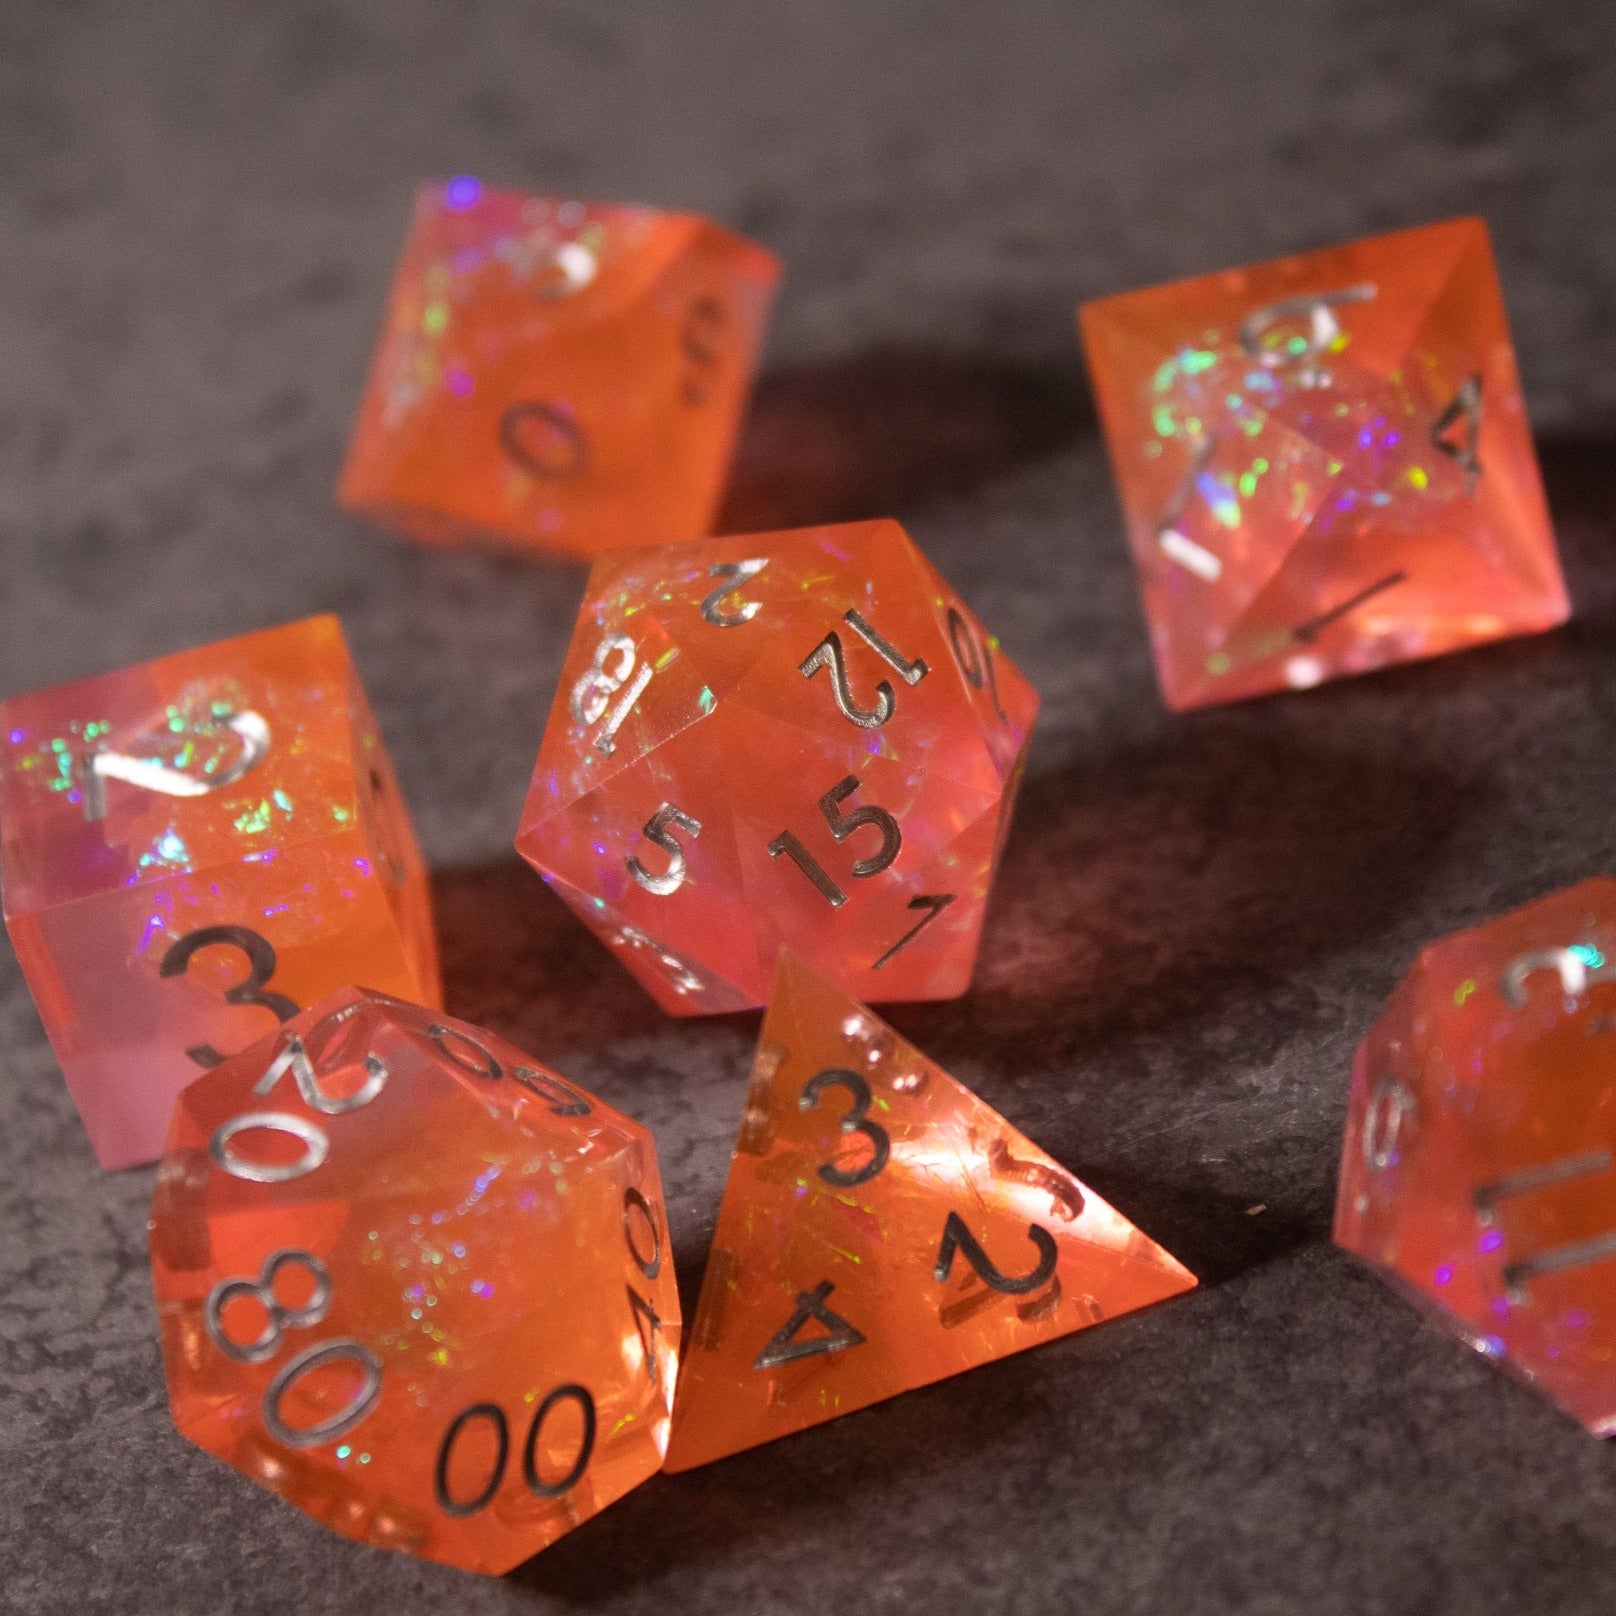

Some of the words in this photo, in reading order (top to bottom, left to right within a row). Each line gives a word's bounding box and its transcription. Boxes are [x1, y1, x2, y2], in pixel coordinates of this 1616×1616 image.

[701, 557, 769, 627] 2
[571, 632, 653, 757] 18
[798, 608, 931, 729] 12
[83, 708, 271, 822] 2
[624, 801, 702, 896] 5
[767, 774, 902, 910] 15
[870, 893, 957, 972] 7
[160, 924, 302, 1068] 3
[209, 1034, 389, 1183] 20
[799, 1067, 891, 1188] 3
[933, 1210, 1058, 1294] 2
[206, 1248, 384, 1448] 80
[753, 1279, 867, 1370] 4
[434, 1383, 597, 1518] 00
